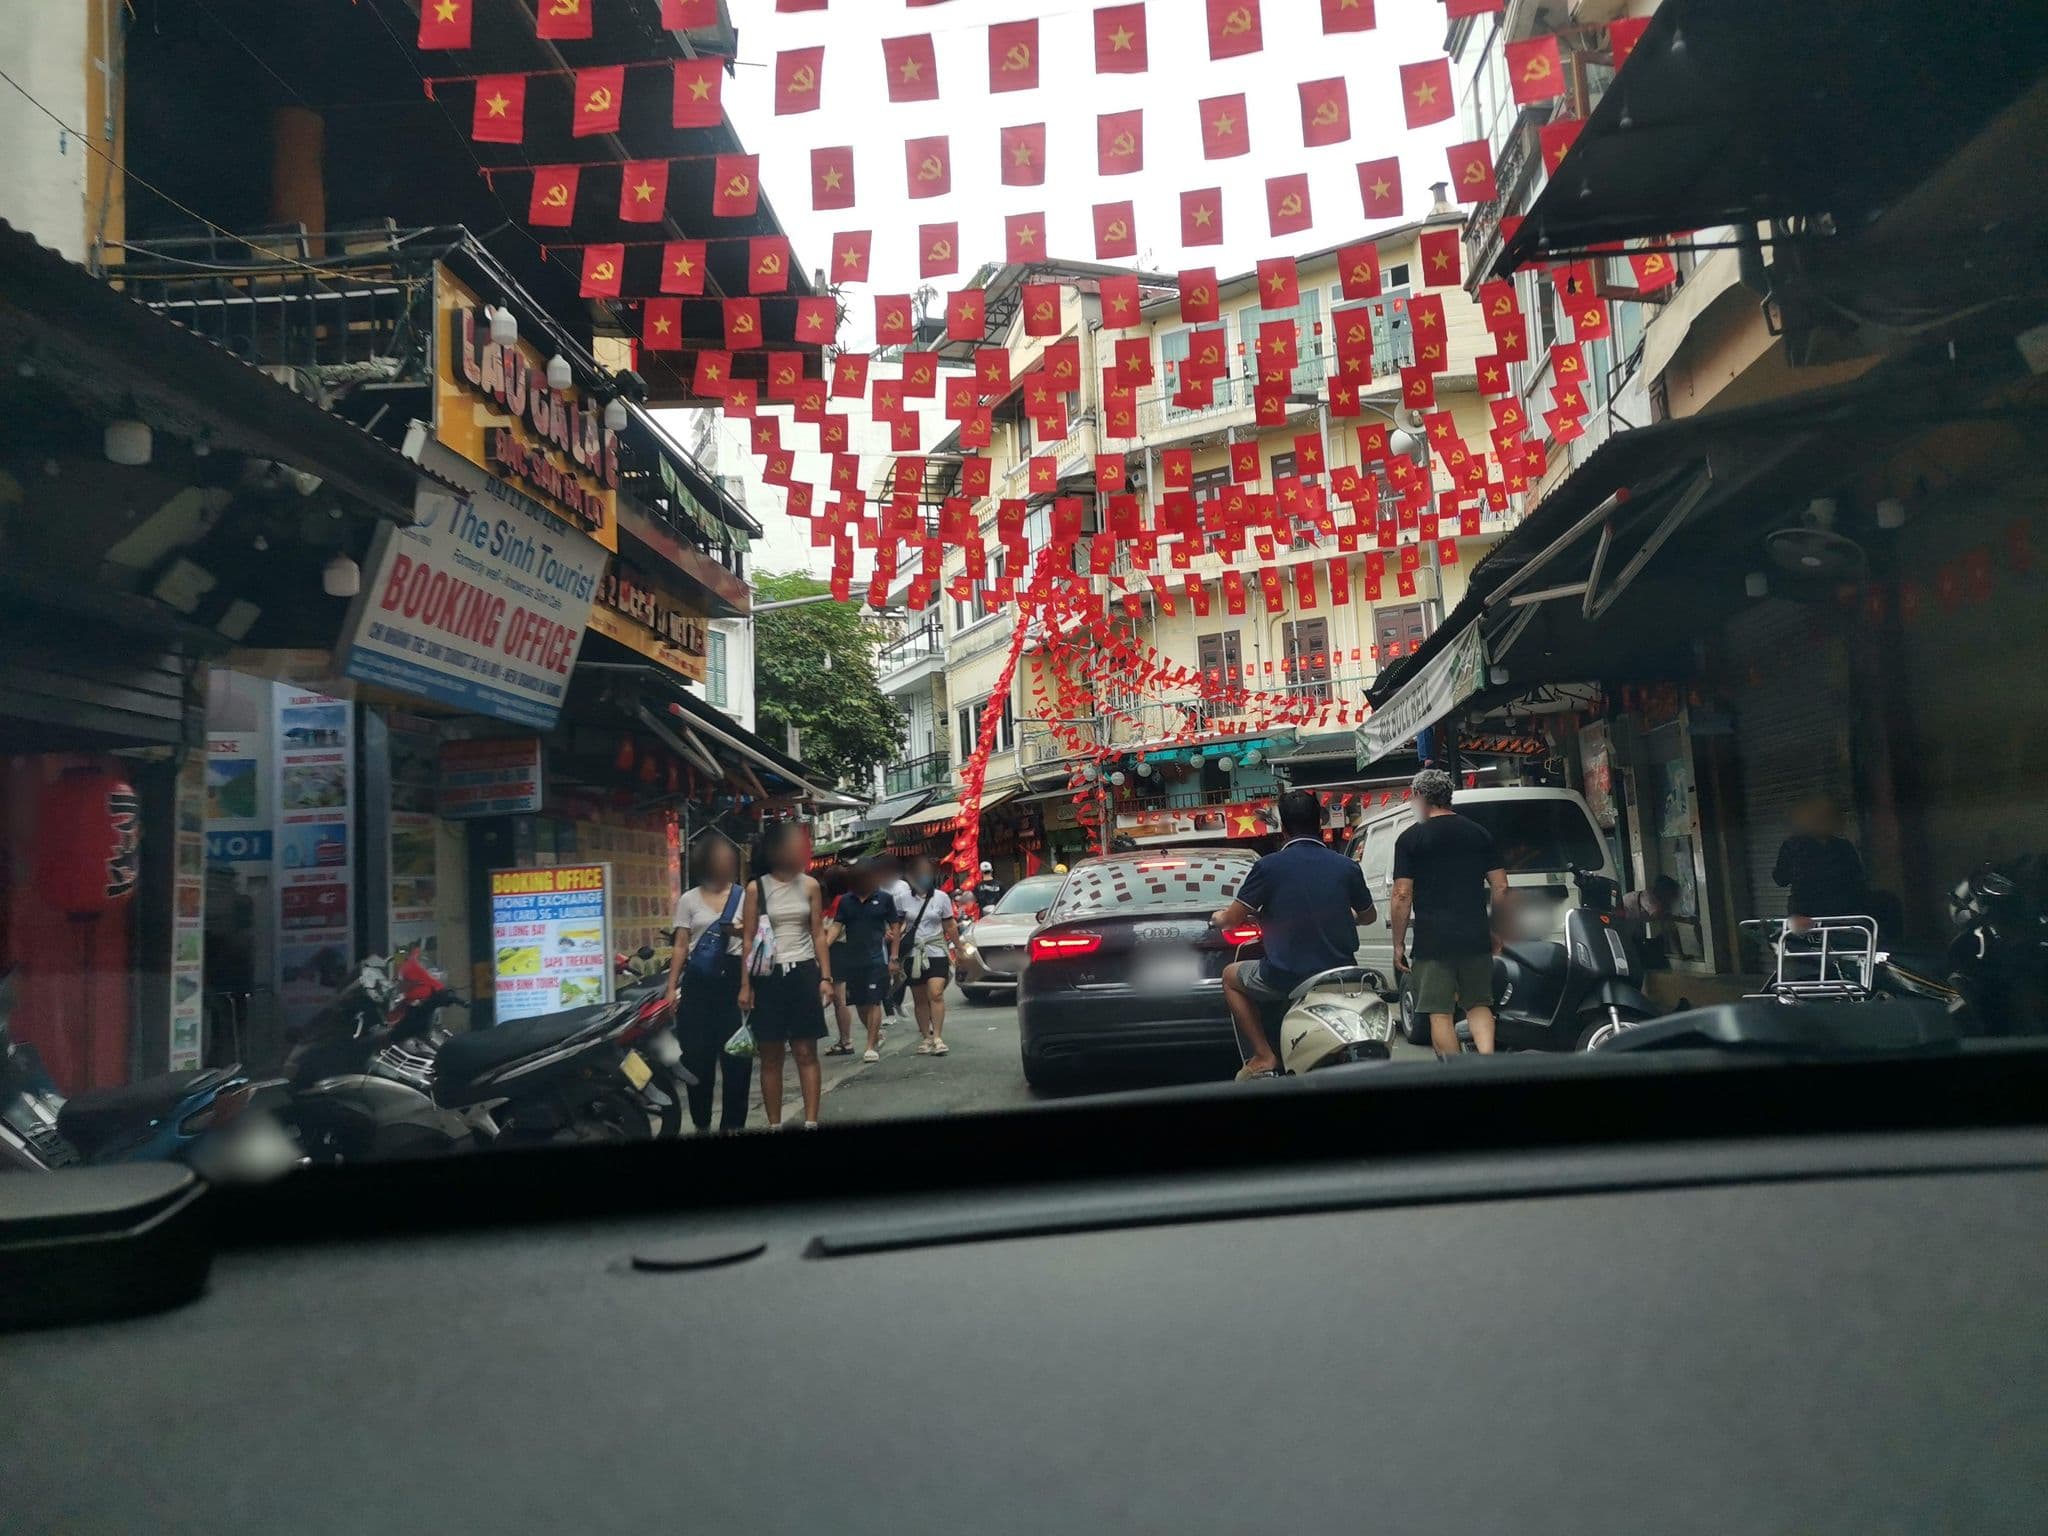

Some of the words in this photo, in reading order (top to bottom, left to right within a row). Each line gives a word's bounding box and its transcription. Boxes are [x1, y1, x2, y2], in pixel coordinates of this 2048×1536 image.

[448, 496, 489, 549] The
[490, 519, 537, 571] Sinh
[537, 543, 596, 603] Tourist
[380, 554, 507, 648] BOOKING
[503, 607, 578, 675] OFFICE
[493, 871, 553, 894] BOOKING
[556, 868, 602, 890] OFFICE
[494, 897, 537, 909] MONEY
[538, 892, 603, 906] EXCHANGE
[508, 924, 530, 937] LONG
